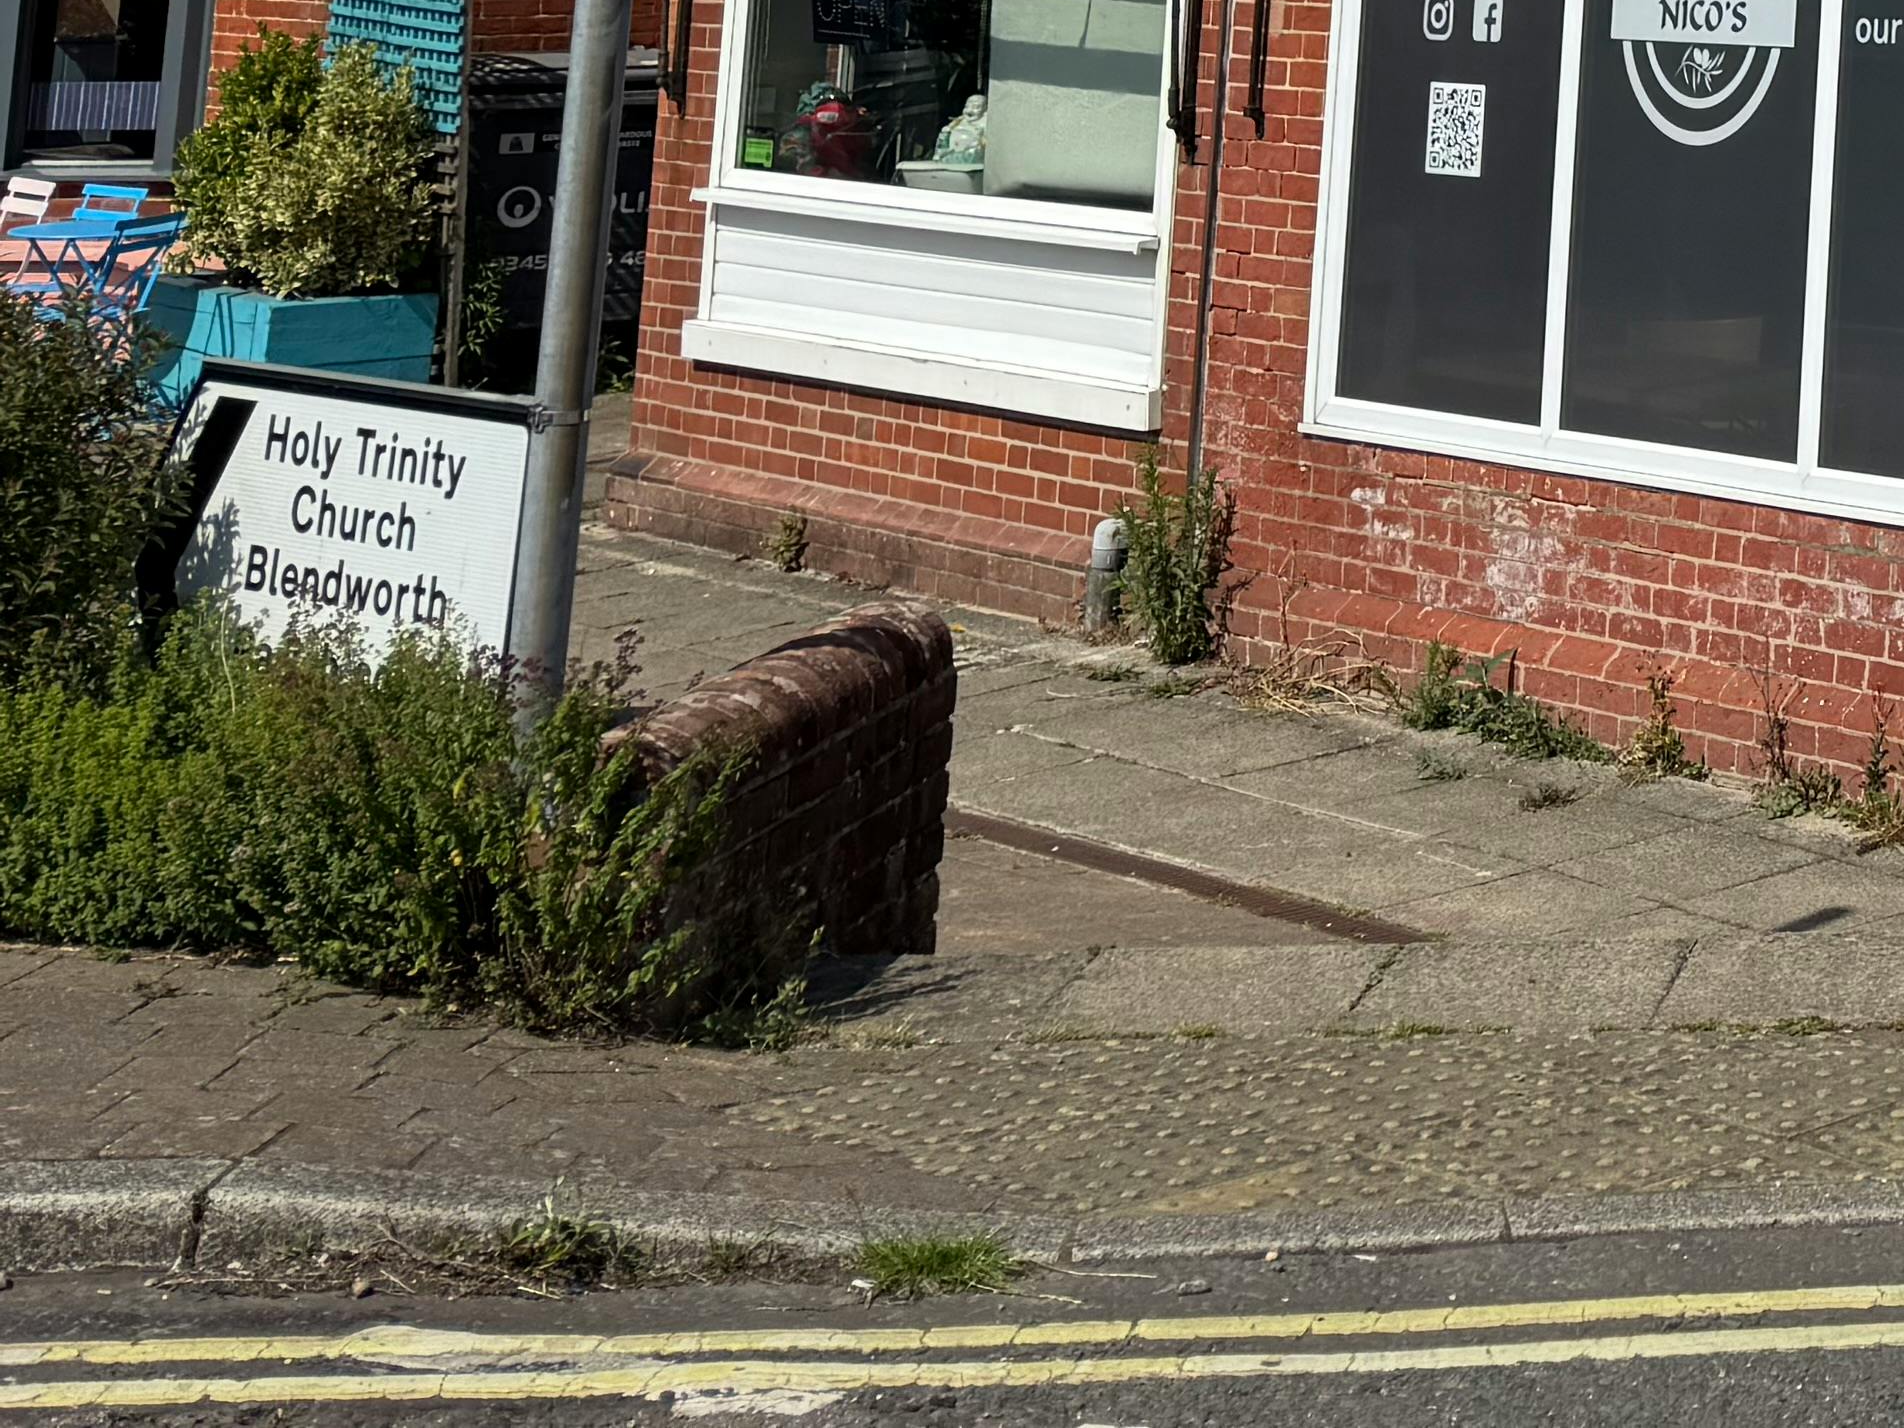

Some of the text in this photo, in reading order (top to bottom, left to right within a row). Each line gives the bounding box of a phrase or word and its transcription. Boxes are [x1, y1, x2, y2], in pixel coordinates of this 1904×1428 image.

[1855, 17, 1903, 44] our
[263, 413, 467, 500] Holy Trinity
[291, 485, 417, 552] Church
[244, 544, 448, 623] Blendworth
